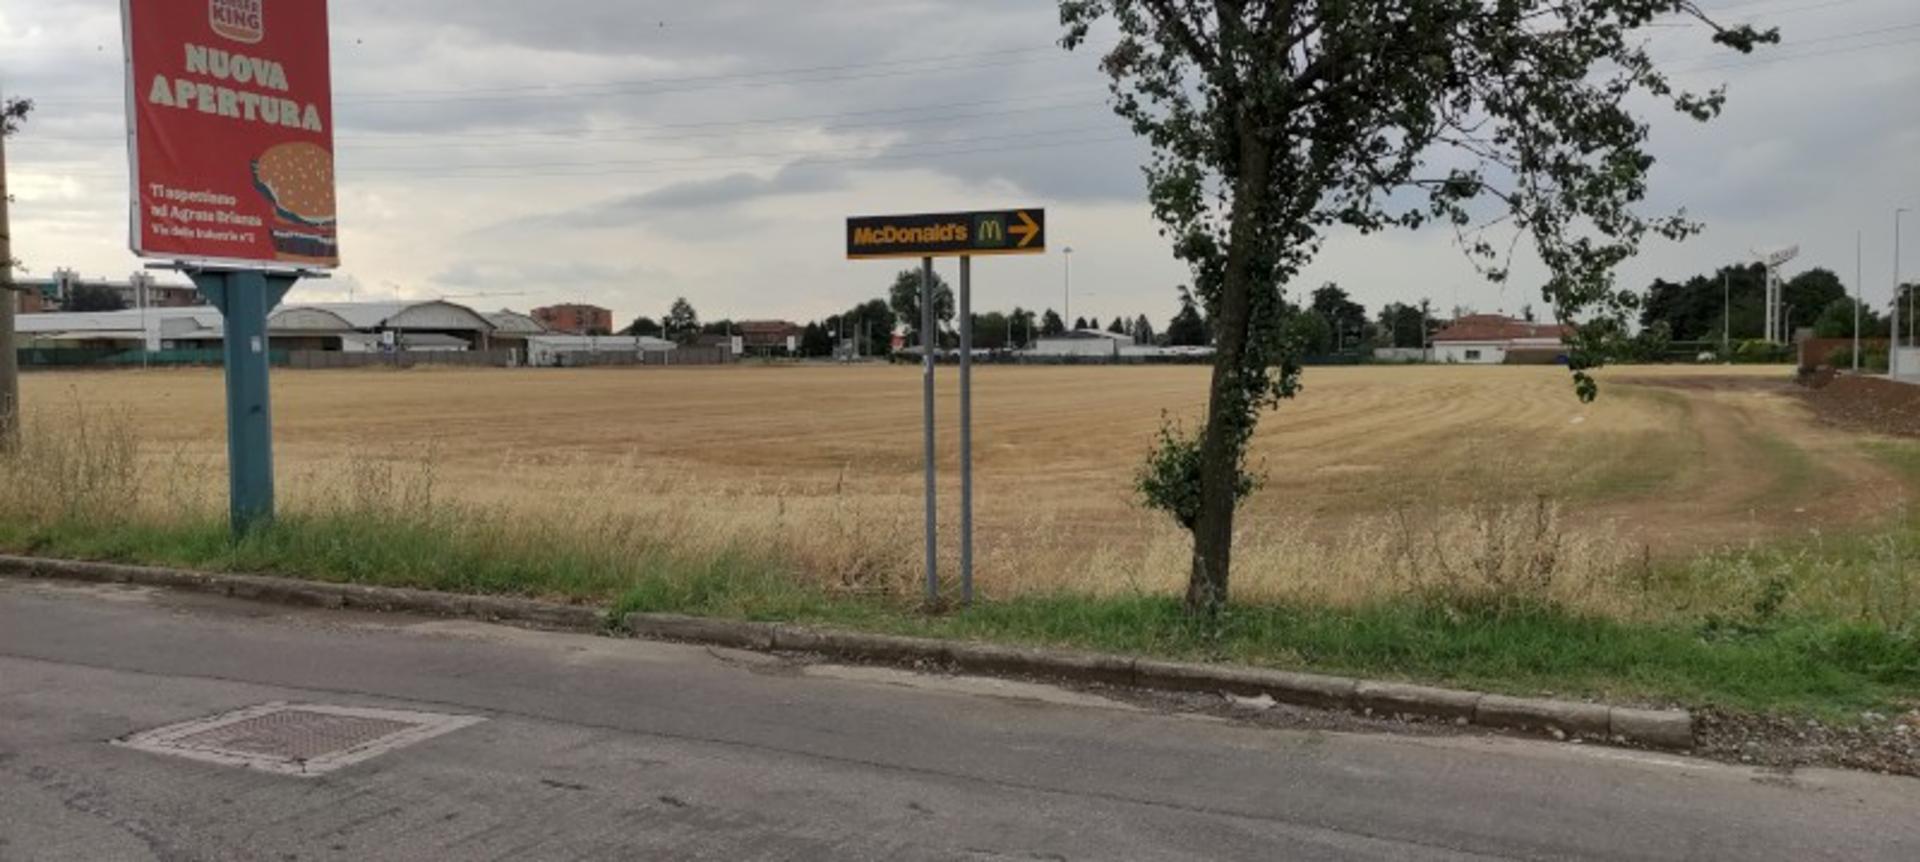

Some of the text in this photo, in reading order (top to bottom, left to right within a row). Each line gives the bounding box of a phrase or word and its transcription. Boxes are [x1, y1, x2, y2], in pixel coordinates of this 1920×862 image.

[212, 5, 260, 30] KING
[184, 42, 289, 91] NUOVA
[149, 73, 323, 132] APERTURA
[149, 183, 164, 198] Ti
[170, 206, 214, 223] Agrate
[854, 222, 969, 245] McDonald's
